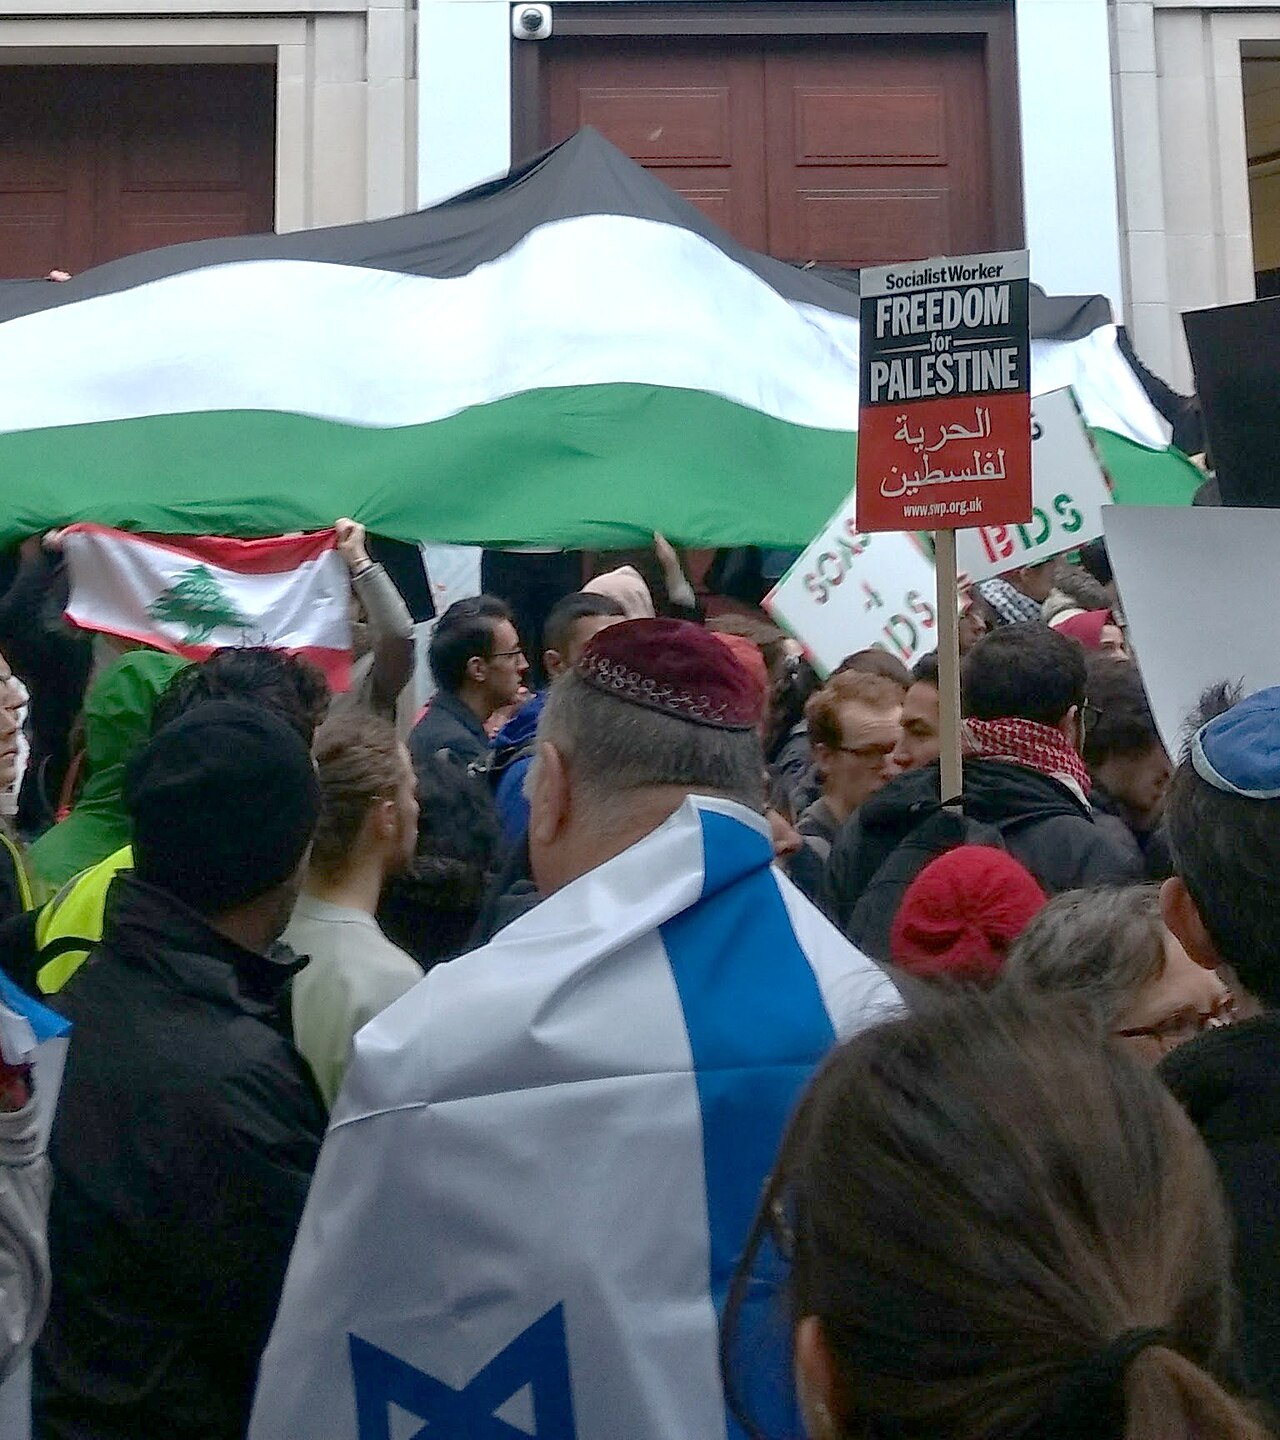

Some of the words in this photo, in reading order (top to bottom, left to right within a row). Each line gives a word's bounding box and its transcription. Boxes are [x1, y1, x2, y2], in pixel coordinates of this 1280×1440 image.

[885, 266, 947, 290] Socialist
[948, 263, 1004, 283] Worker
[876, 284, 1010, 339] FREEDOM
[929, 331, 952, 353] for
[870, 346, 1020, 403] PALESTINE
[893, 406, 992, 453] الحرية
[879, 447, 1007, 498] لفلسطين
[903, 496, 983, 518] www.swp.org.uk
[976, 492, 1083, 563] BDS
[882, 590, 935, 661] DS
